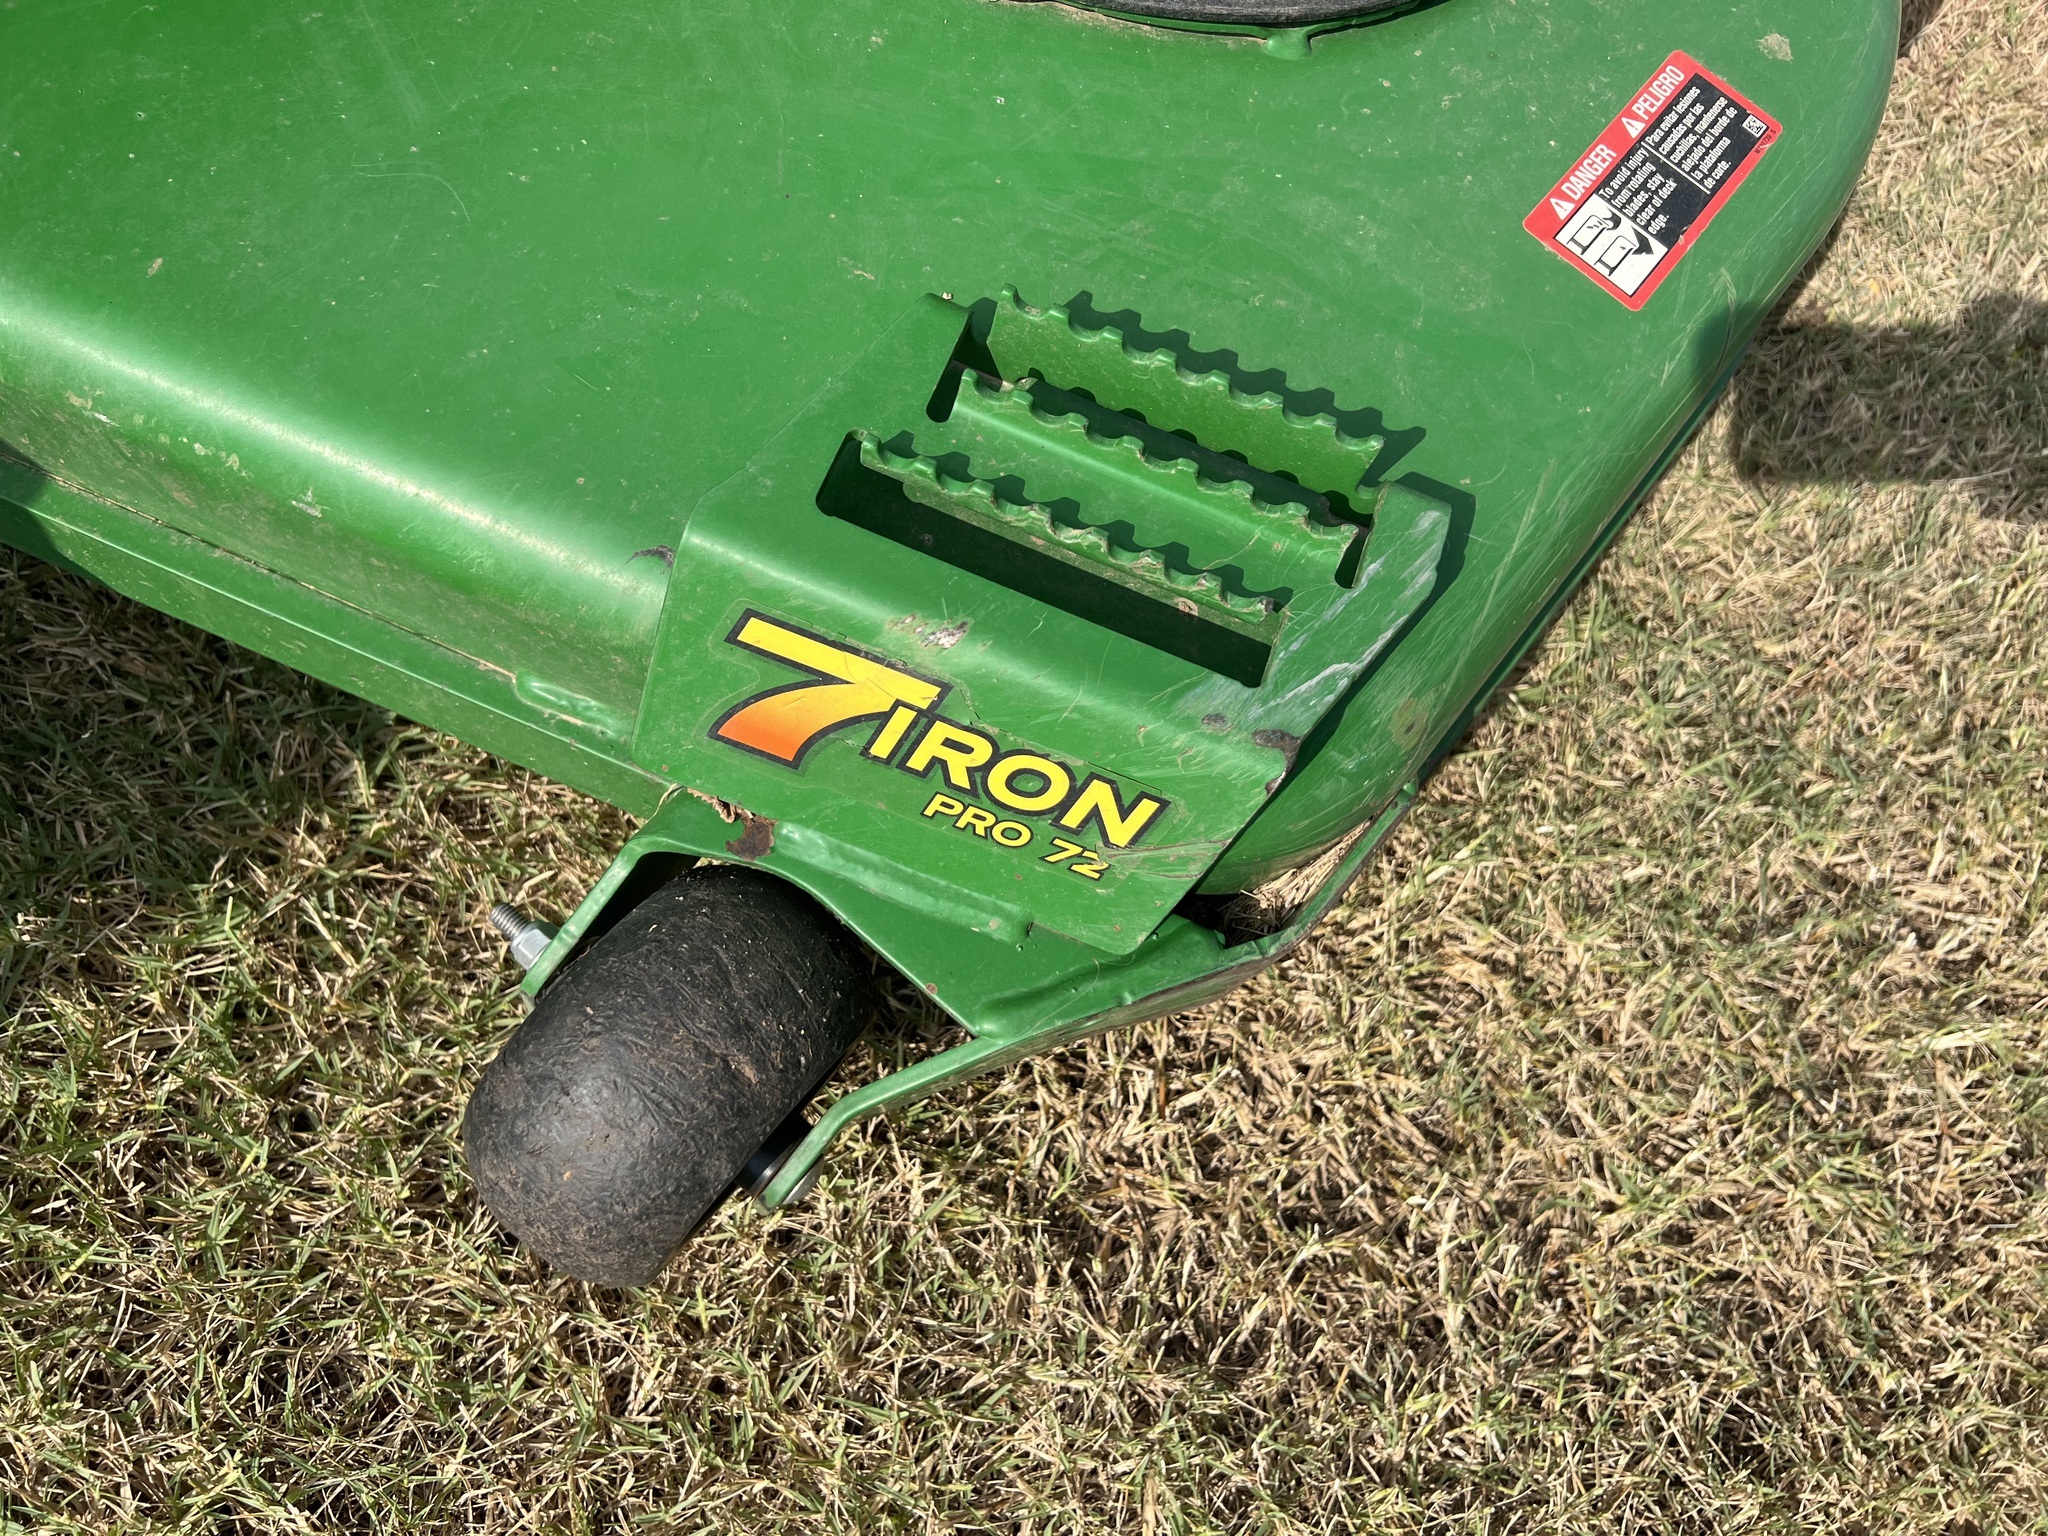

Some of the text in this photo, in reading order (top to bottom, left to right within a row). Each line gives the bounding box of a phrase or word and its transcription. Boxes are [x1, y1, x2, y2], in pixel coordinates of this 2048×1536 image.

[1631, 65, 1684, 120] PELIGRO
[1645, 86, 1700, 146] Para evitar lesiones
[1659, 103, 1704, 155] causadas por las
[1670, 97, 1728, 163] cuchillas, mantenerse
[1682, 107, 1737, 172] alejado del borde de
[1561, 144, 1617, 200] DANGER
[1599, 147, 1649, 198] To avoid injury
[1691, 137, 1731, 180] la plataforma
[1703, 161, 1731, 189] de corte.
[1611, 162, 1656, 208] from rotating
[1622, 173, 1665, 217] blades, stay
[1636, 180, 1677, 225] clear of deck
[1648, 214, 1669, 234] edge.
[707, 608, 1169, 850] 7 IRON
[921, 793, 1112, 880] PRO 72
